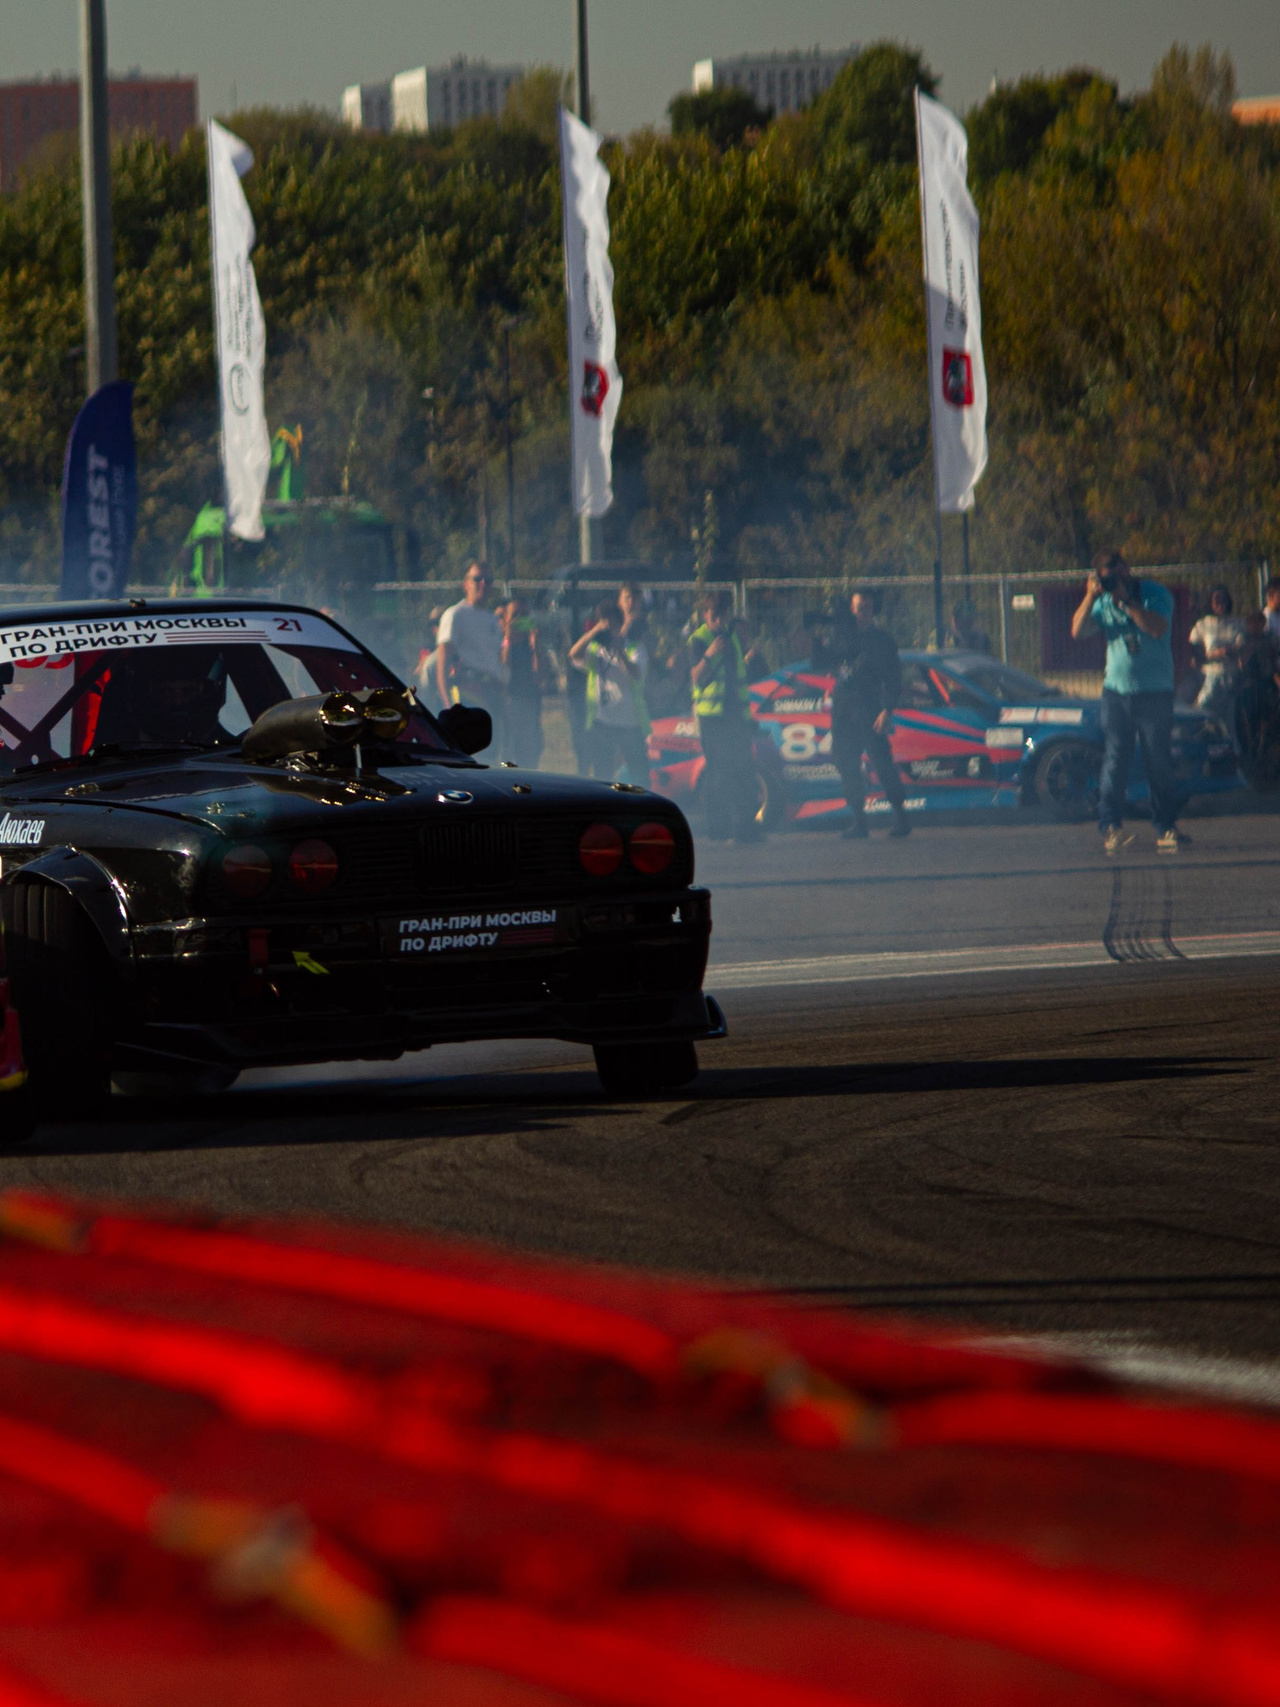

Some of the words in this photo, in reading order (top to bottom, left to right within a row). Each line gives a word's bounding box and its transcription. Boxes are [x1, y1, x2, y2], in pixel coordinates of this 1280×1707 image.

[87, 444, 113, 599] OREST
[0, 620, 128, 645] ГРАН-ПРИ
[134, 617, 247, 632] МОСКВЫ
[272, 618, 303, 632] 21
[10, 643, 48, 658] ПО
[54, 633, 159, 654] ДРИФТУ
[397, 914, 482, 934] ГРАН-ПРИ
[485, 909, 557, 927] МОСКВЫ
[399, 937, 425, 952] ПО
[428, 932, 499, 952] ДРИФТУ
